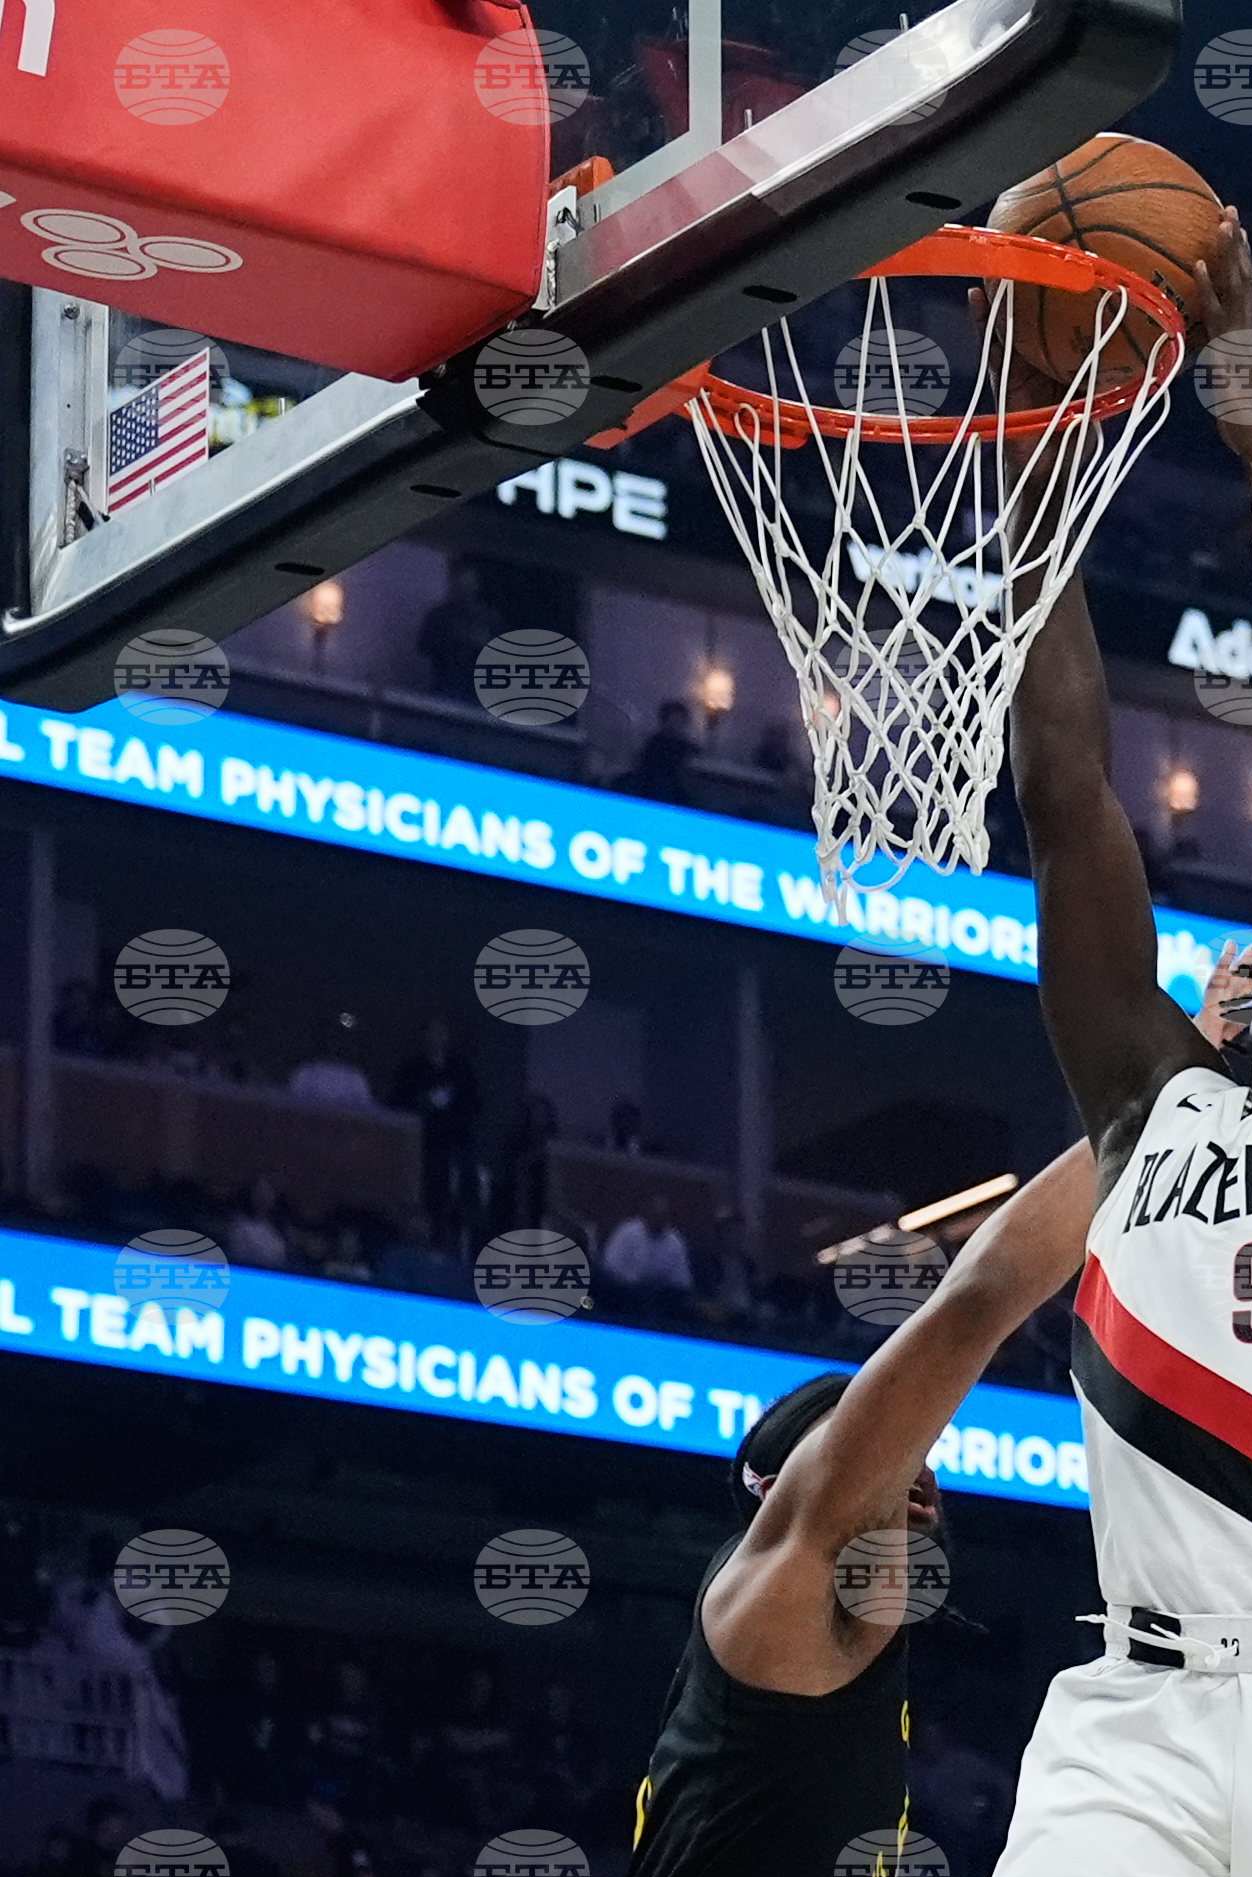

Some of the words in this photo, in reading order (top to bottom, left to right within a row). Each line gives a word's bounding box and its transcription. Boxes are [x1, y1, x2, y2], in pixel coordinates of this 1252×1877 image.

[39, 718, 204, 798] TEAM
[219, 756, 558, 869] PHYSICIANS
[568, 829, 647, 884] OF
[659, 847, 765, 912] THE
[50, 1286, 225, 1364] TEAM
[242, 1316, 599, 1419] PHYSICIANS
[612, 1374, 696, 1431] OF
[927, 1425, 1091, 1492] RRIOR
